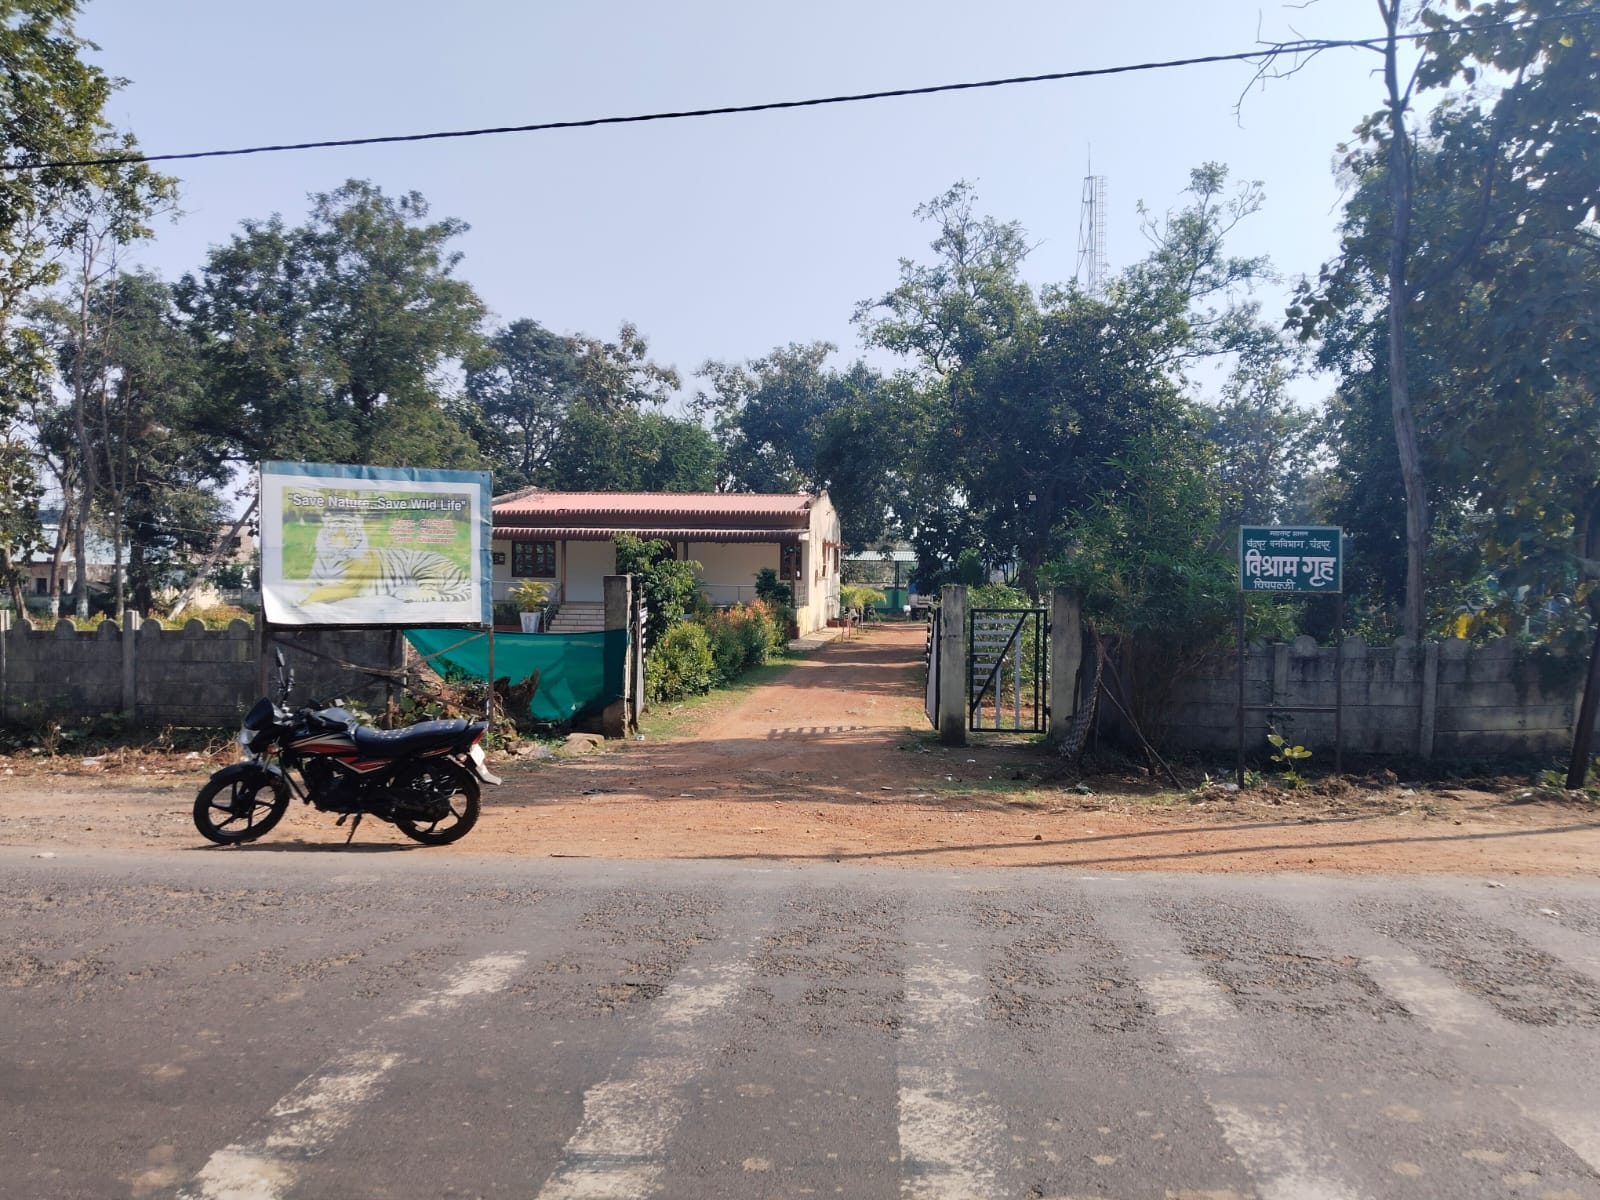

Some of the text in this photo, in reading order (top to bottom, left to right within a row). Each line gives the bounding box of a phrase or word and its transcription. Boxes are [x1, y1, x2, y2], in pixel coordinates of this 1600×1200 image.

[378, 497, 406, 510] Save
[410, 499, 437, 511] Wild
[440, 499, 466, 511] Life"
[1245, 549, 1337, 587] विश्राम गृह
